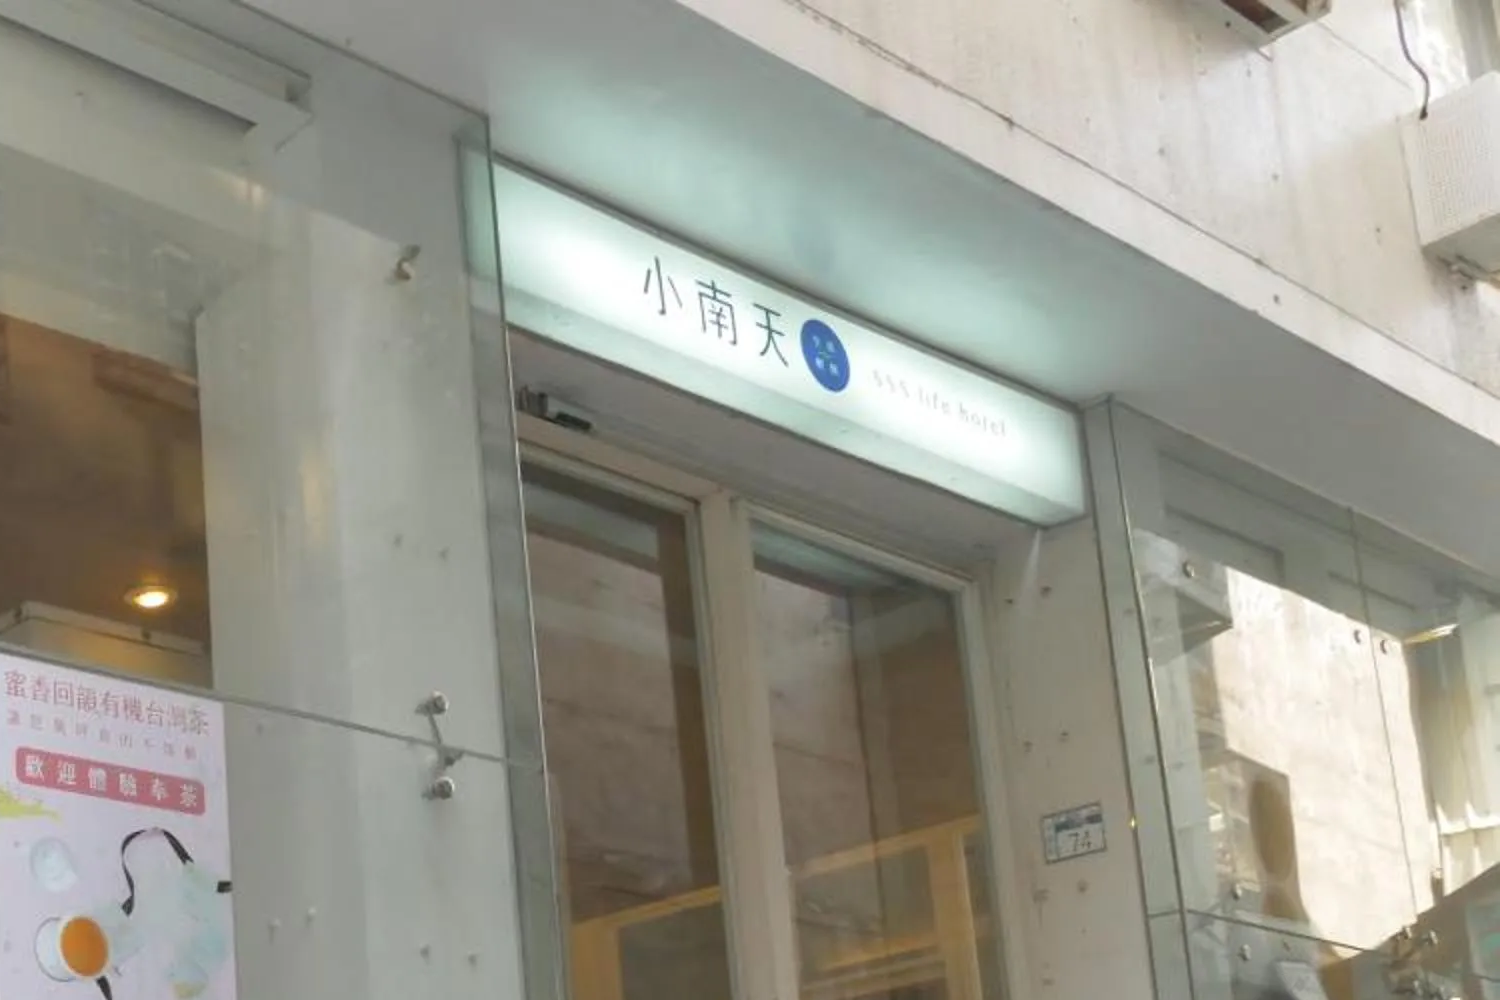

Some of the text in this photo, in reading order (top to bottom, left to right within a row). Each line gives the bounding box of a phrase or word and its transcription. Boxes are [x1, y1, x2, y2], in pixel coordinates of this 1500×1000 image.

[643, 255, 789, 368] 小南天
[958, 401, 1007, 437] hotel
